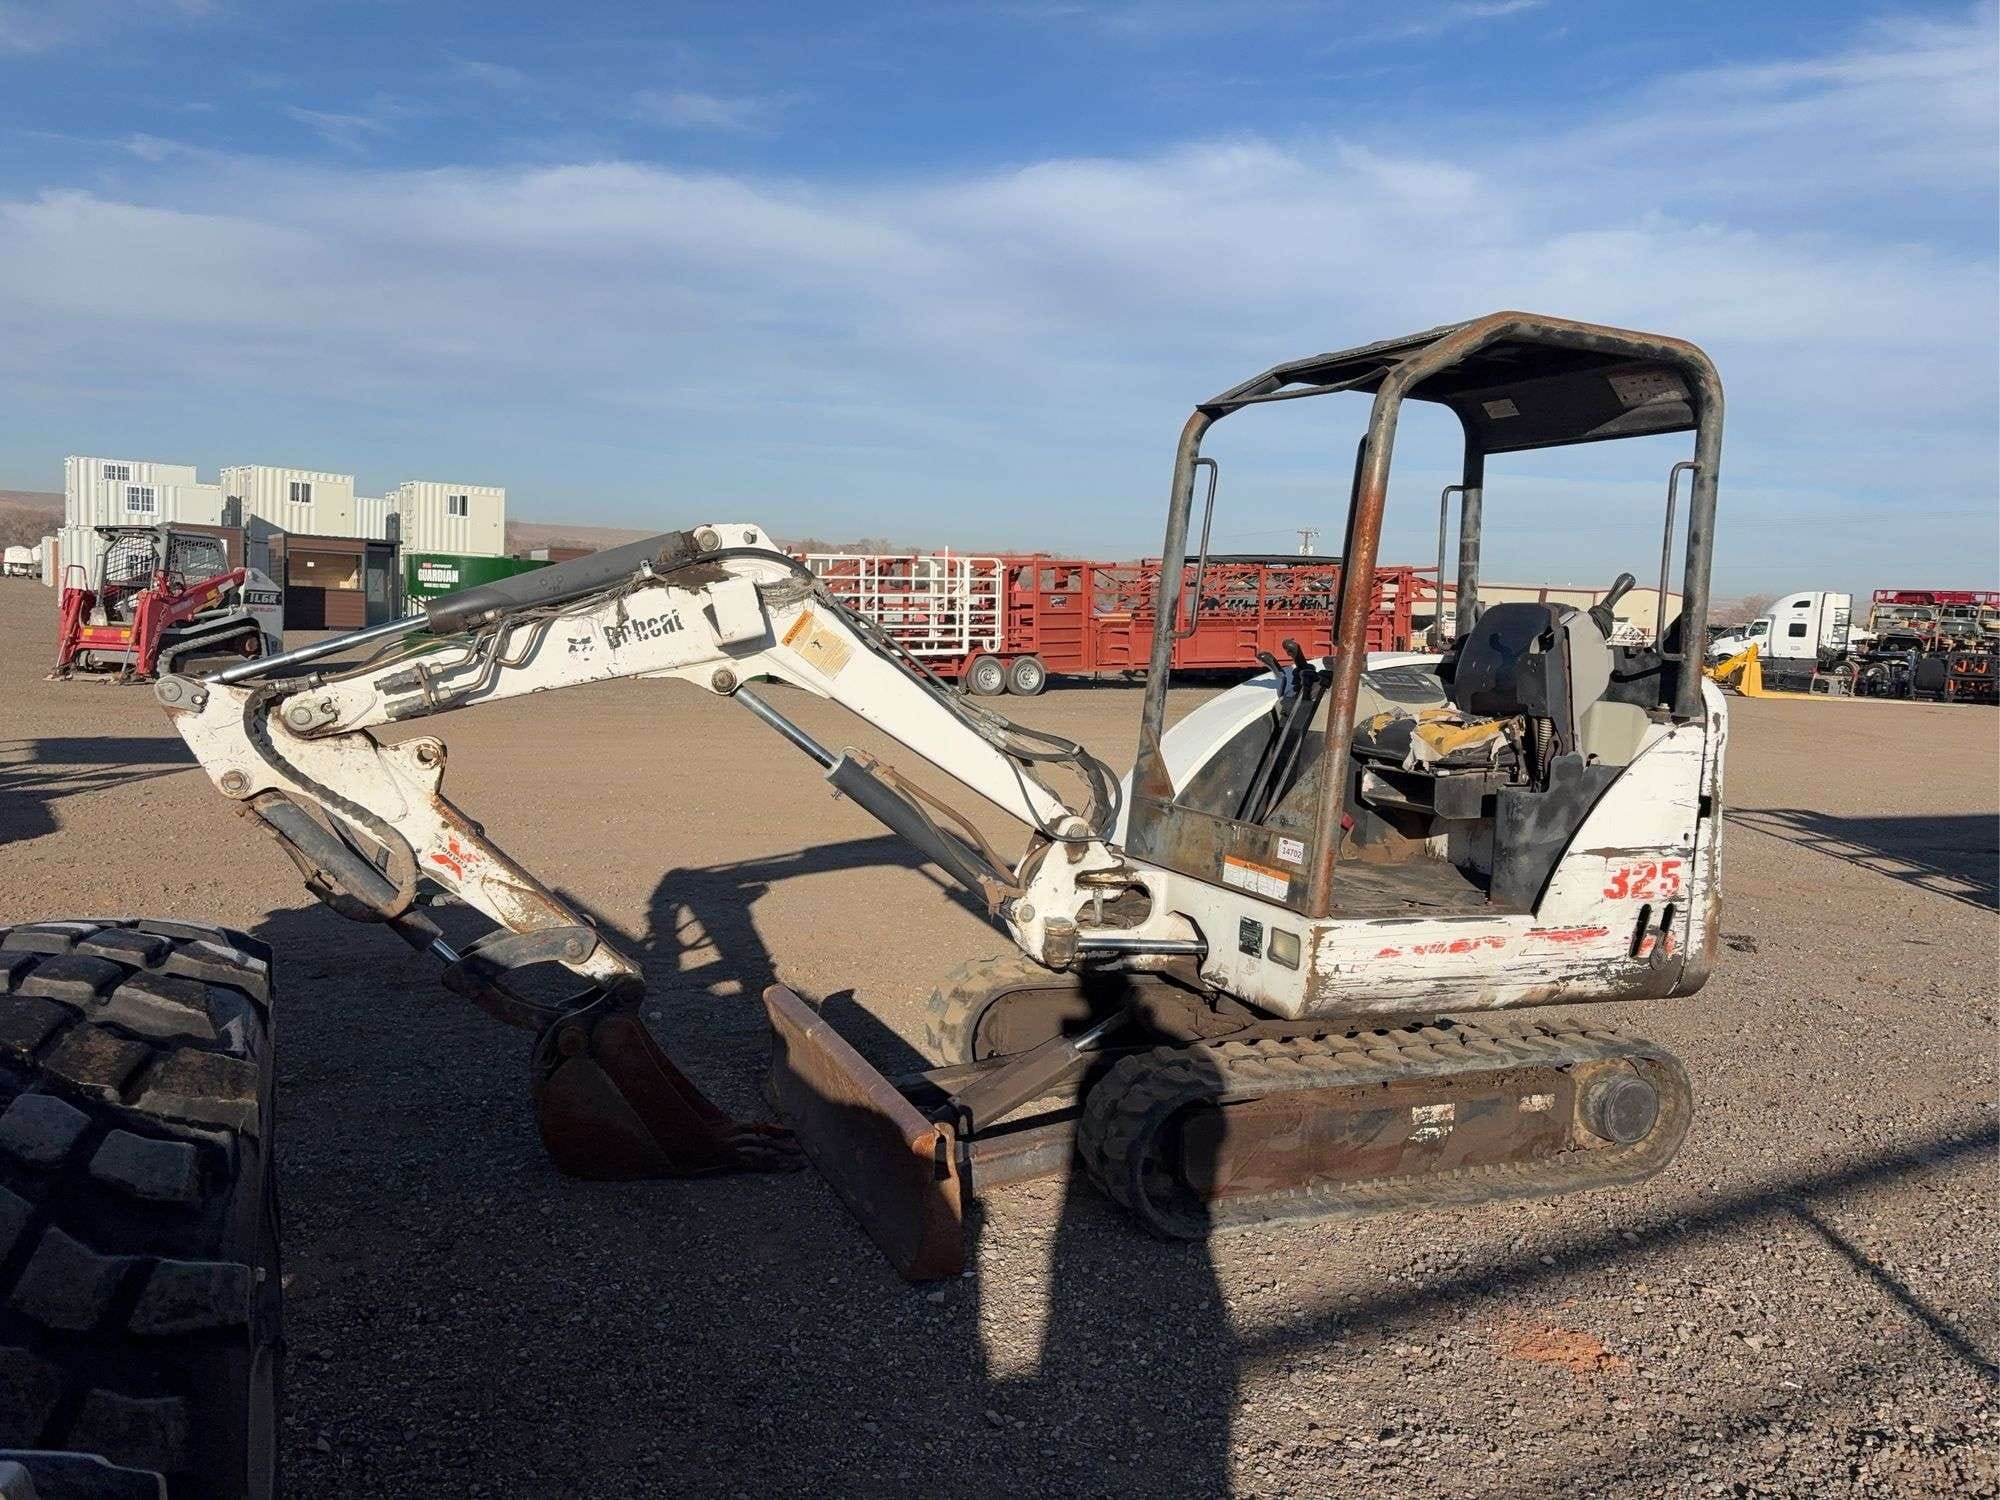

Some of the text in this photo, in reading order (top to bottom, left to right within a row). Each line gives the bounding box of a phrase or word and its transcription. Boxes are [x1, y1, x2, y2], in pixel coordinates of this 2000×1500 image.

[418, 569, 459, 583] GUARDIAN
[1282, 847, 1302, 859] 14702
[1603, 860, 1681, 900] 325
